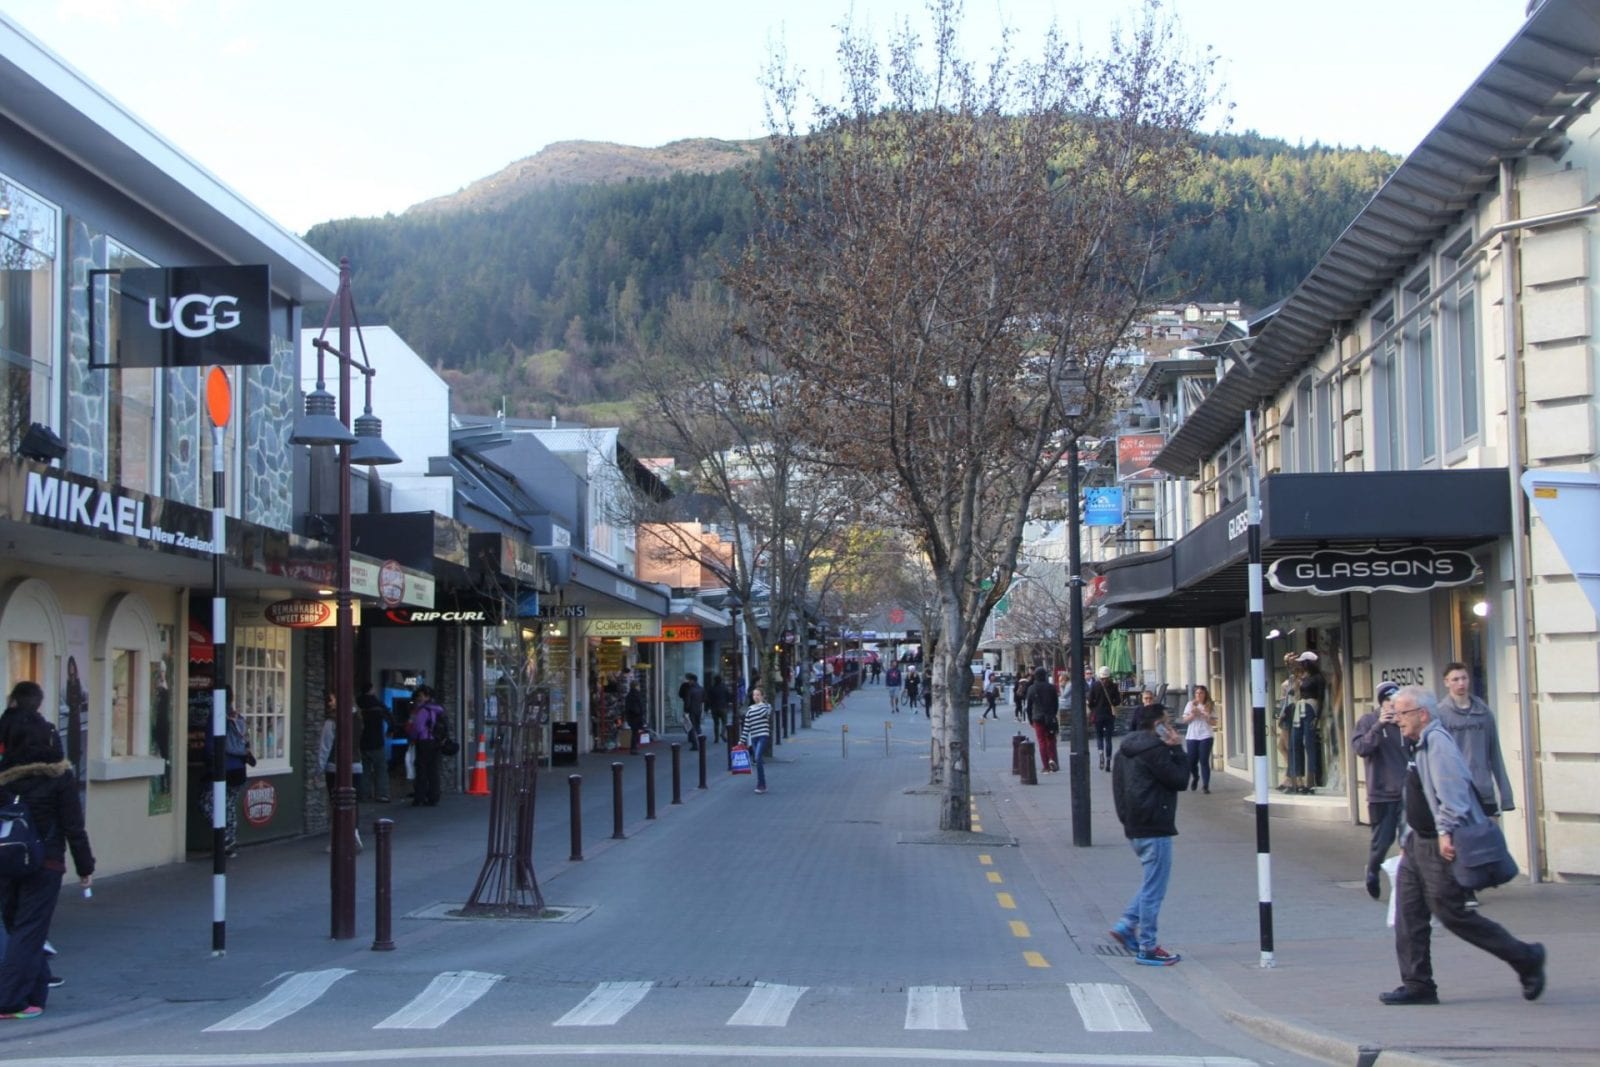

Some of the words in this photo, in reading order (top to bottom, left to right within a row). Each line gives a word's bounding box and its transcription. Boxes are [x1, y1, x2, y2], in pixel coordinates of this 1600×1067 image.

[147, 293, 241, 338] UGG
[26, 471, 151, 539] MIKAEL
[152, 527, 175, 545] New
[176, 532, 214, 553] Zealand
[1296, 558, 1454, 579] GLASSONS
[271, 603, 324, 615] REMARKABLE
[300, 613, 320, 623] SHOP
[410, 612, 441, 621] RIP
[441, 611, 486, 621] CURL
[595, 620, 642, 631] Collective
